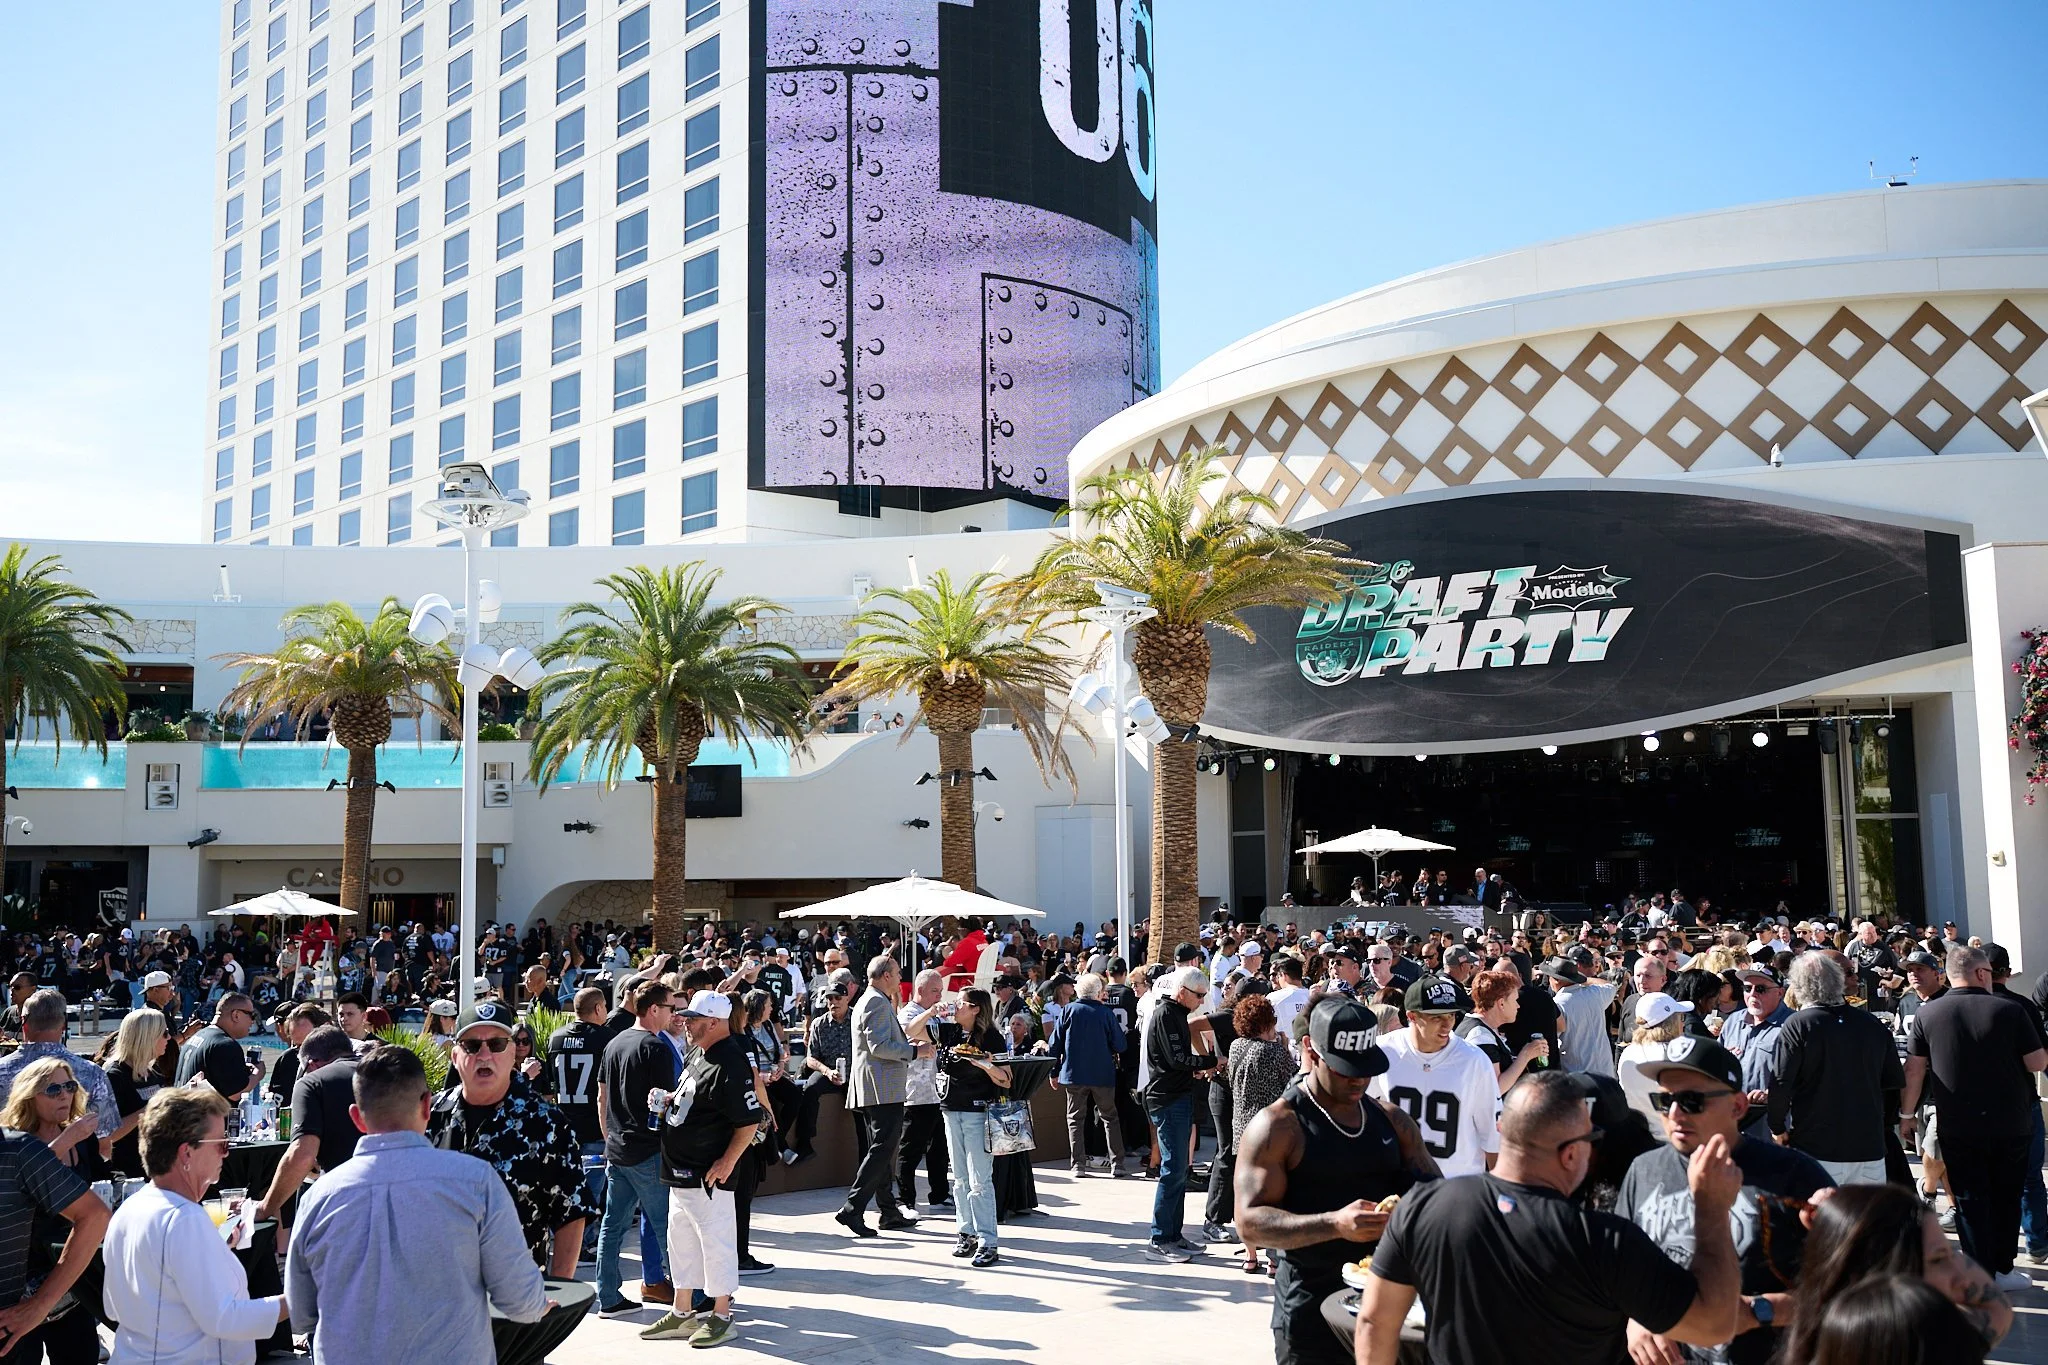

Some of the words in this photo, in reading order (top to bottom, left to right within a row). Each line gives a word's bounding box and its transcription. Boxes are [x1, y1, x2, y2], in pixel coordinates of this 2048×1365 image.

[1335, 559, 1412, 587] 026
[1532, 581, 1607, 601] Modelo
[1296, 565, 1537, 638] DRAFT
[1304, 640, 1355, 652] RAIDERS
[1360, 607, 1634, 678] PARTY
[287, 867, 405, 887] CASNO
[485, 947, 499, 961] 87
[1426, 984, 1441, 999] LAS
[562, 1036, 585, 1049] ADAMS
[554, 1053, 594, 1104] 17
